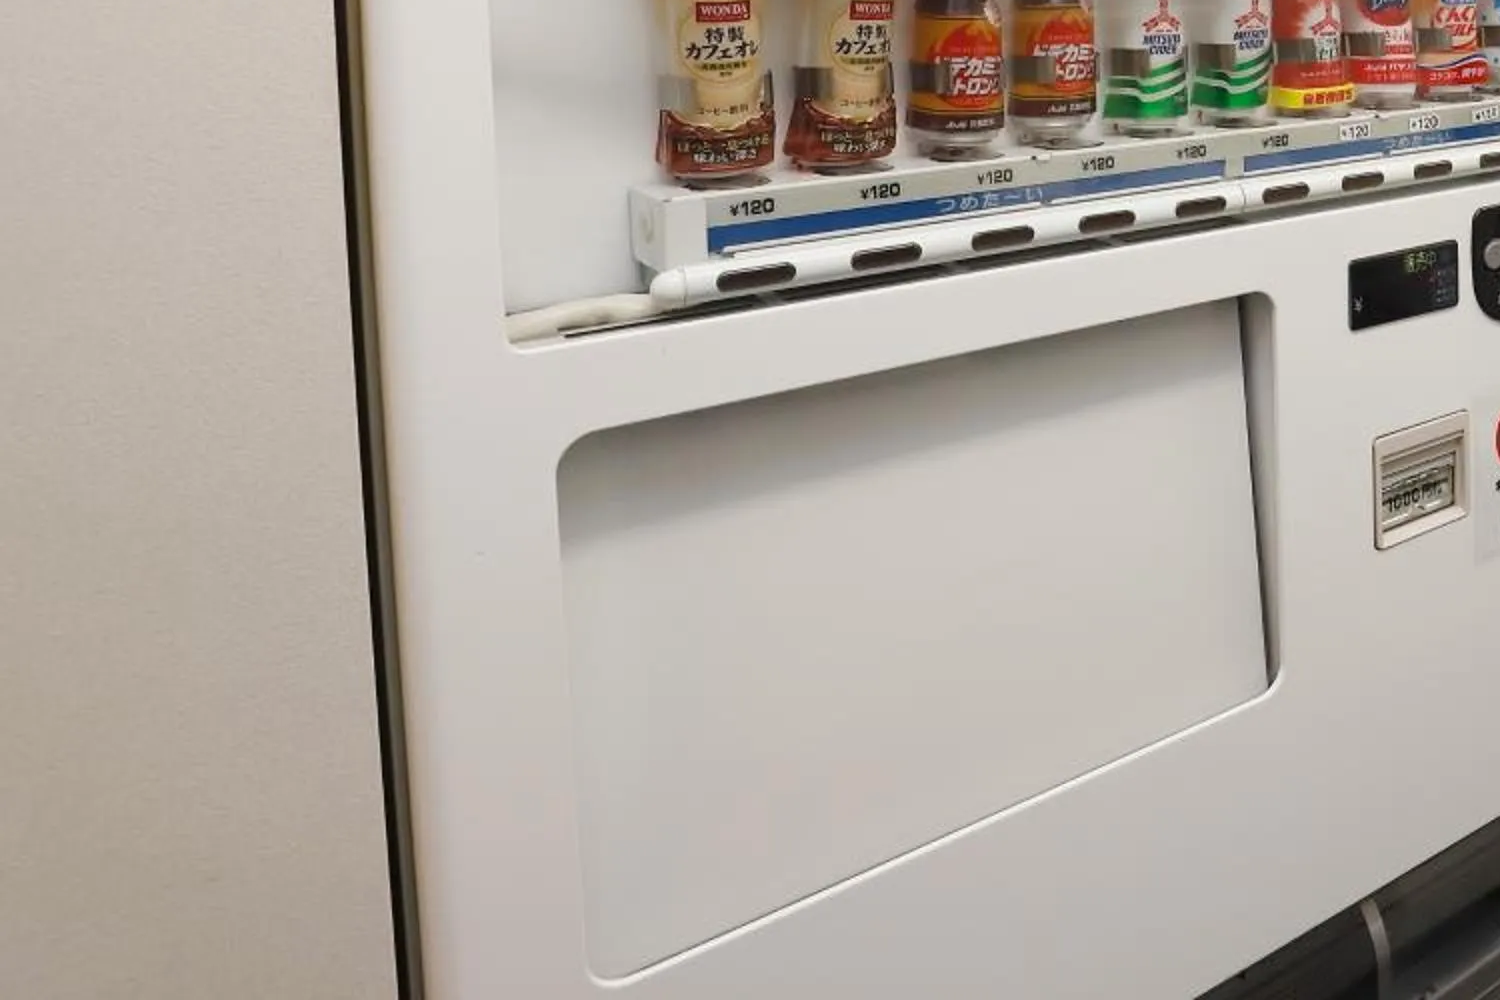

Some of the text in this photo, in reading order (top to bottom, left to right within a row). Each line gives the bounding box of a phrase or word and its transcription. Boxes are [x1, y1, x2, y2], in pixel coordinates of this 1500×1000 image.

[700, 2, 748, 17] WONDA
[704, 25, 745, 43] 特製
[685, 40, 759, 60] カフェオレ
[1177, 144, 1207, 158] ¥120
[1082, 156, 1115, 171] ¥120
[977, 169, 1013, 185] ¥120
[860, 183, 901, 200] ¥120
[730, 199, 775, 217] ¥120
